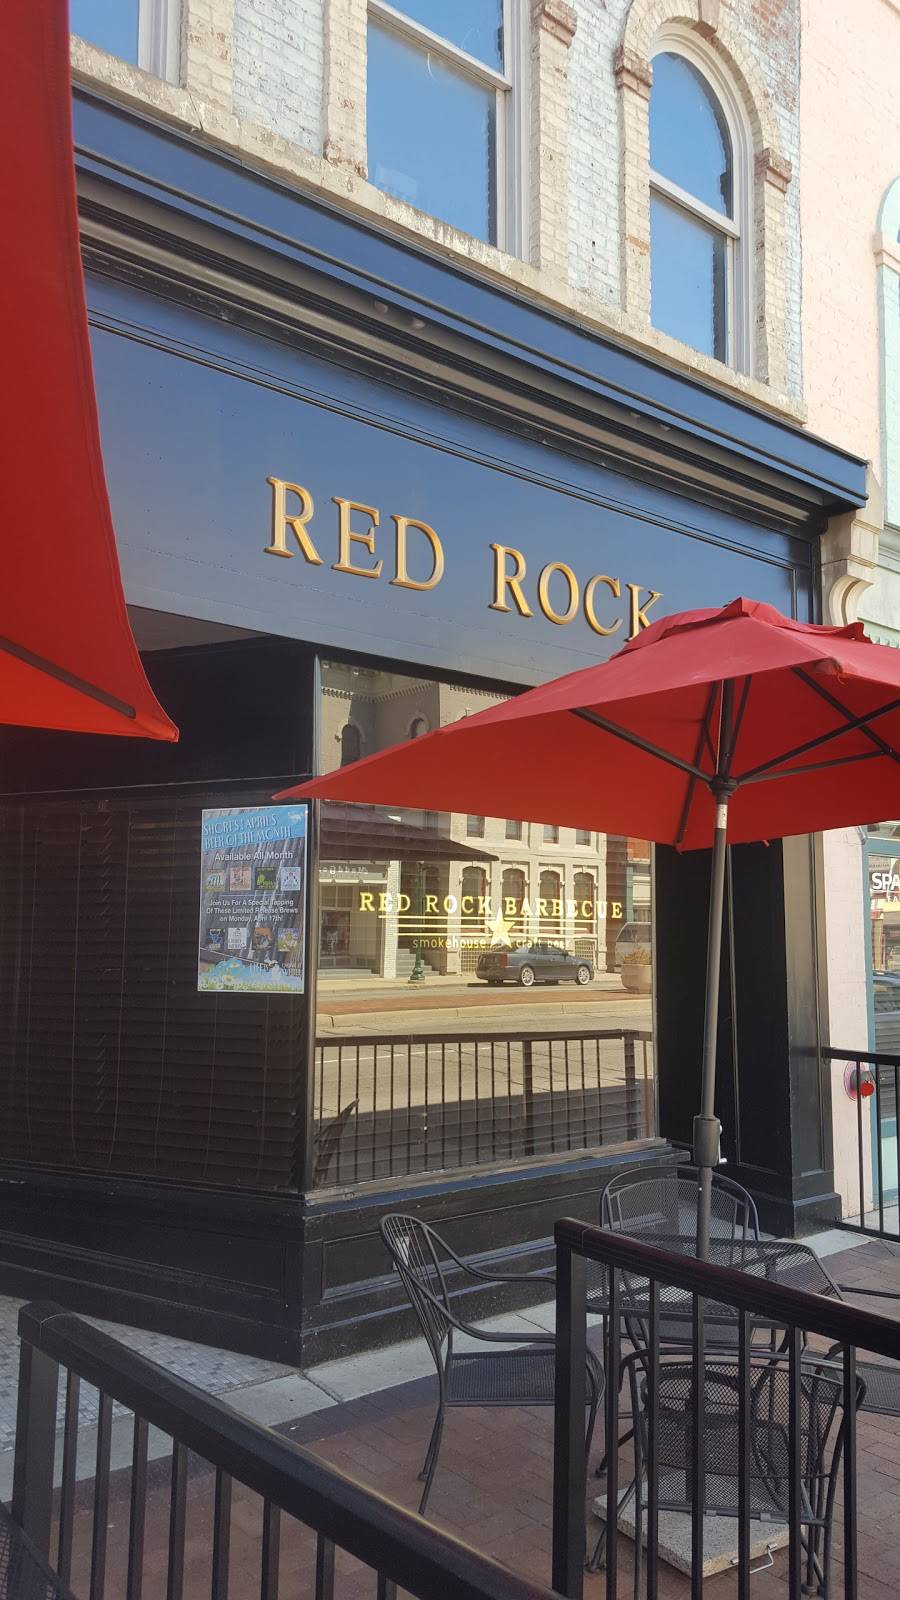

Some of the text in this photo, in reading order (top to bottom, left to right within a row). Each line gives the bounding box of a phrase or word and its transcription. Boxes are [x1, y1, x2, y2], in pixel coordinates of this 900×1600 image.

[263, 475, 664, 643] RED ROCK
[239, 831, 255, 844] THE
[257, 824, 293, 842] MONTH
[215, 851, 293, 861] Available All Month
[248, 899, 269, 907] Special
[271, 899, 294, 907] Tapping
[359, 892, 623, 919] RED ROCK BARBECUE
[412, 937, 487, 949] smokehouse
[515, 937, 571, 950] craft beer
